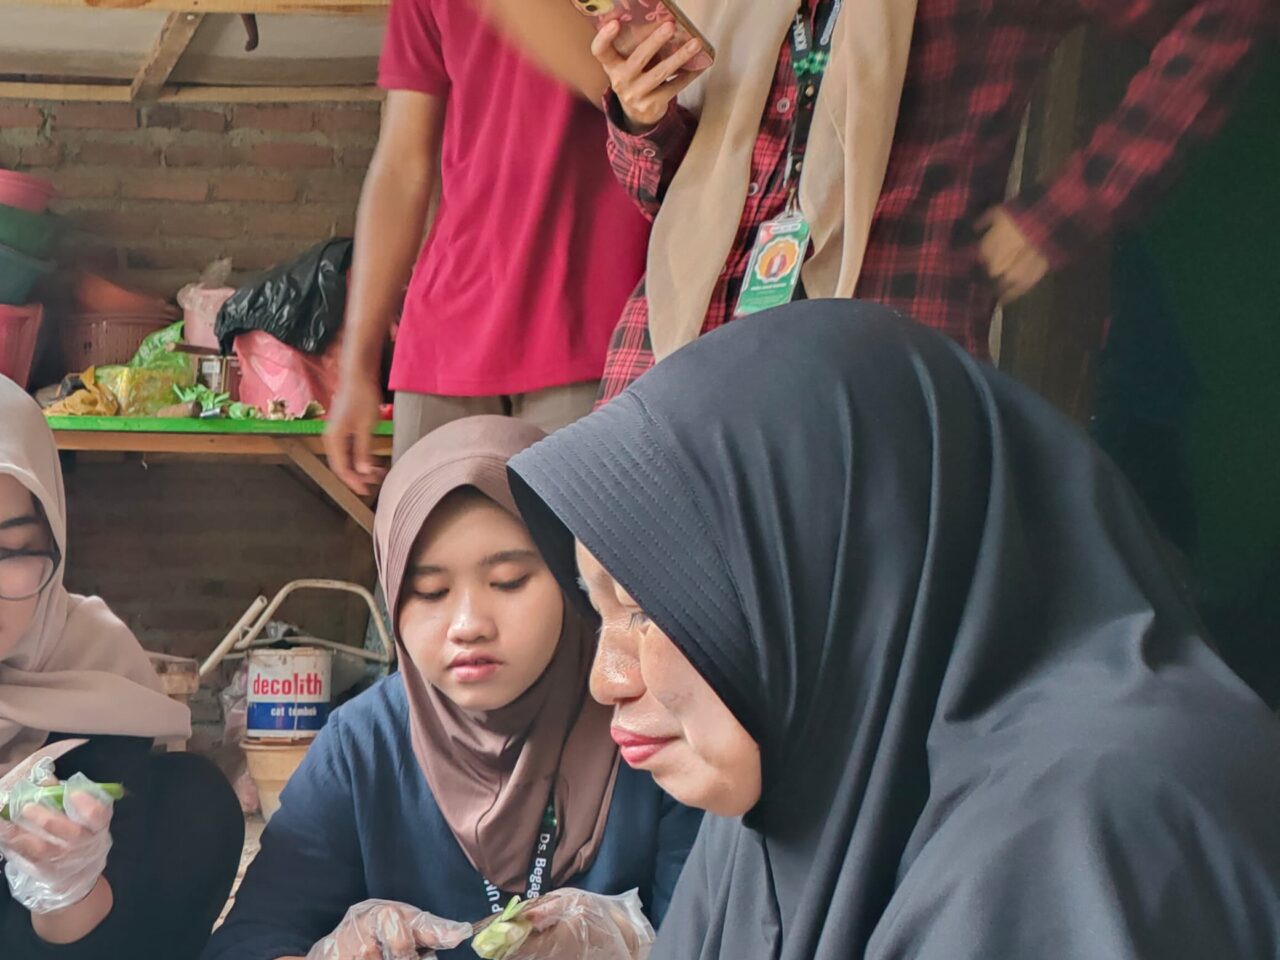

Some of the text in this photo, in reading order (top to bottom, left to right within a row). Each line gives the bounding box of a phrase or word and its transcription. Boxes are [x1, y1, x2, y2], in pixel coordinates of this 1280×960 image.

[252, 672, 323, 696] decolith
[270, 706, 285, 717] cat
[537, 833, 551, 854] Ds.
